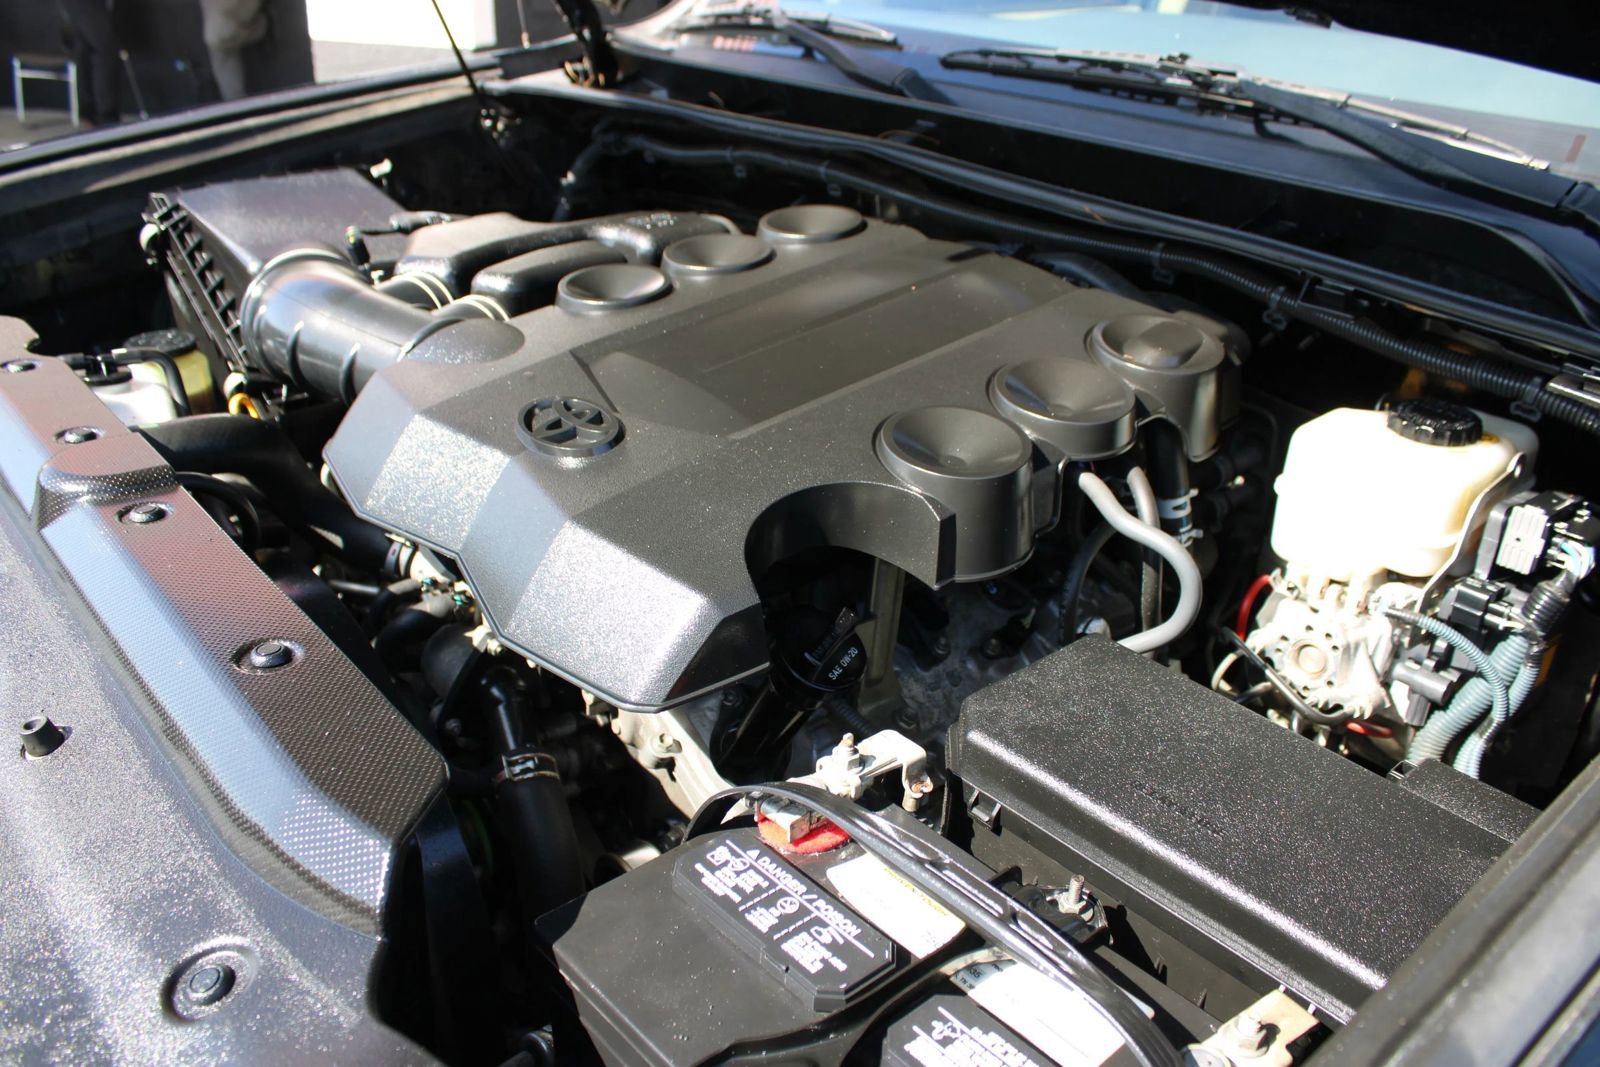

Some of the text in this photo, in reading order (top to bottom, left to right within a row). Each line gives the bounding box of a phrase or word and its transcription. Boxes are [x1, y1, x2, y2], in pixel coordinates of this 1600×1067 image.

[827, 664, 844, 681] SAE
[840, 647, 859, 667] 0W-20
[757, 855, 807, 895] DANGER
[813, 898, 862, 937] POISON
